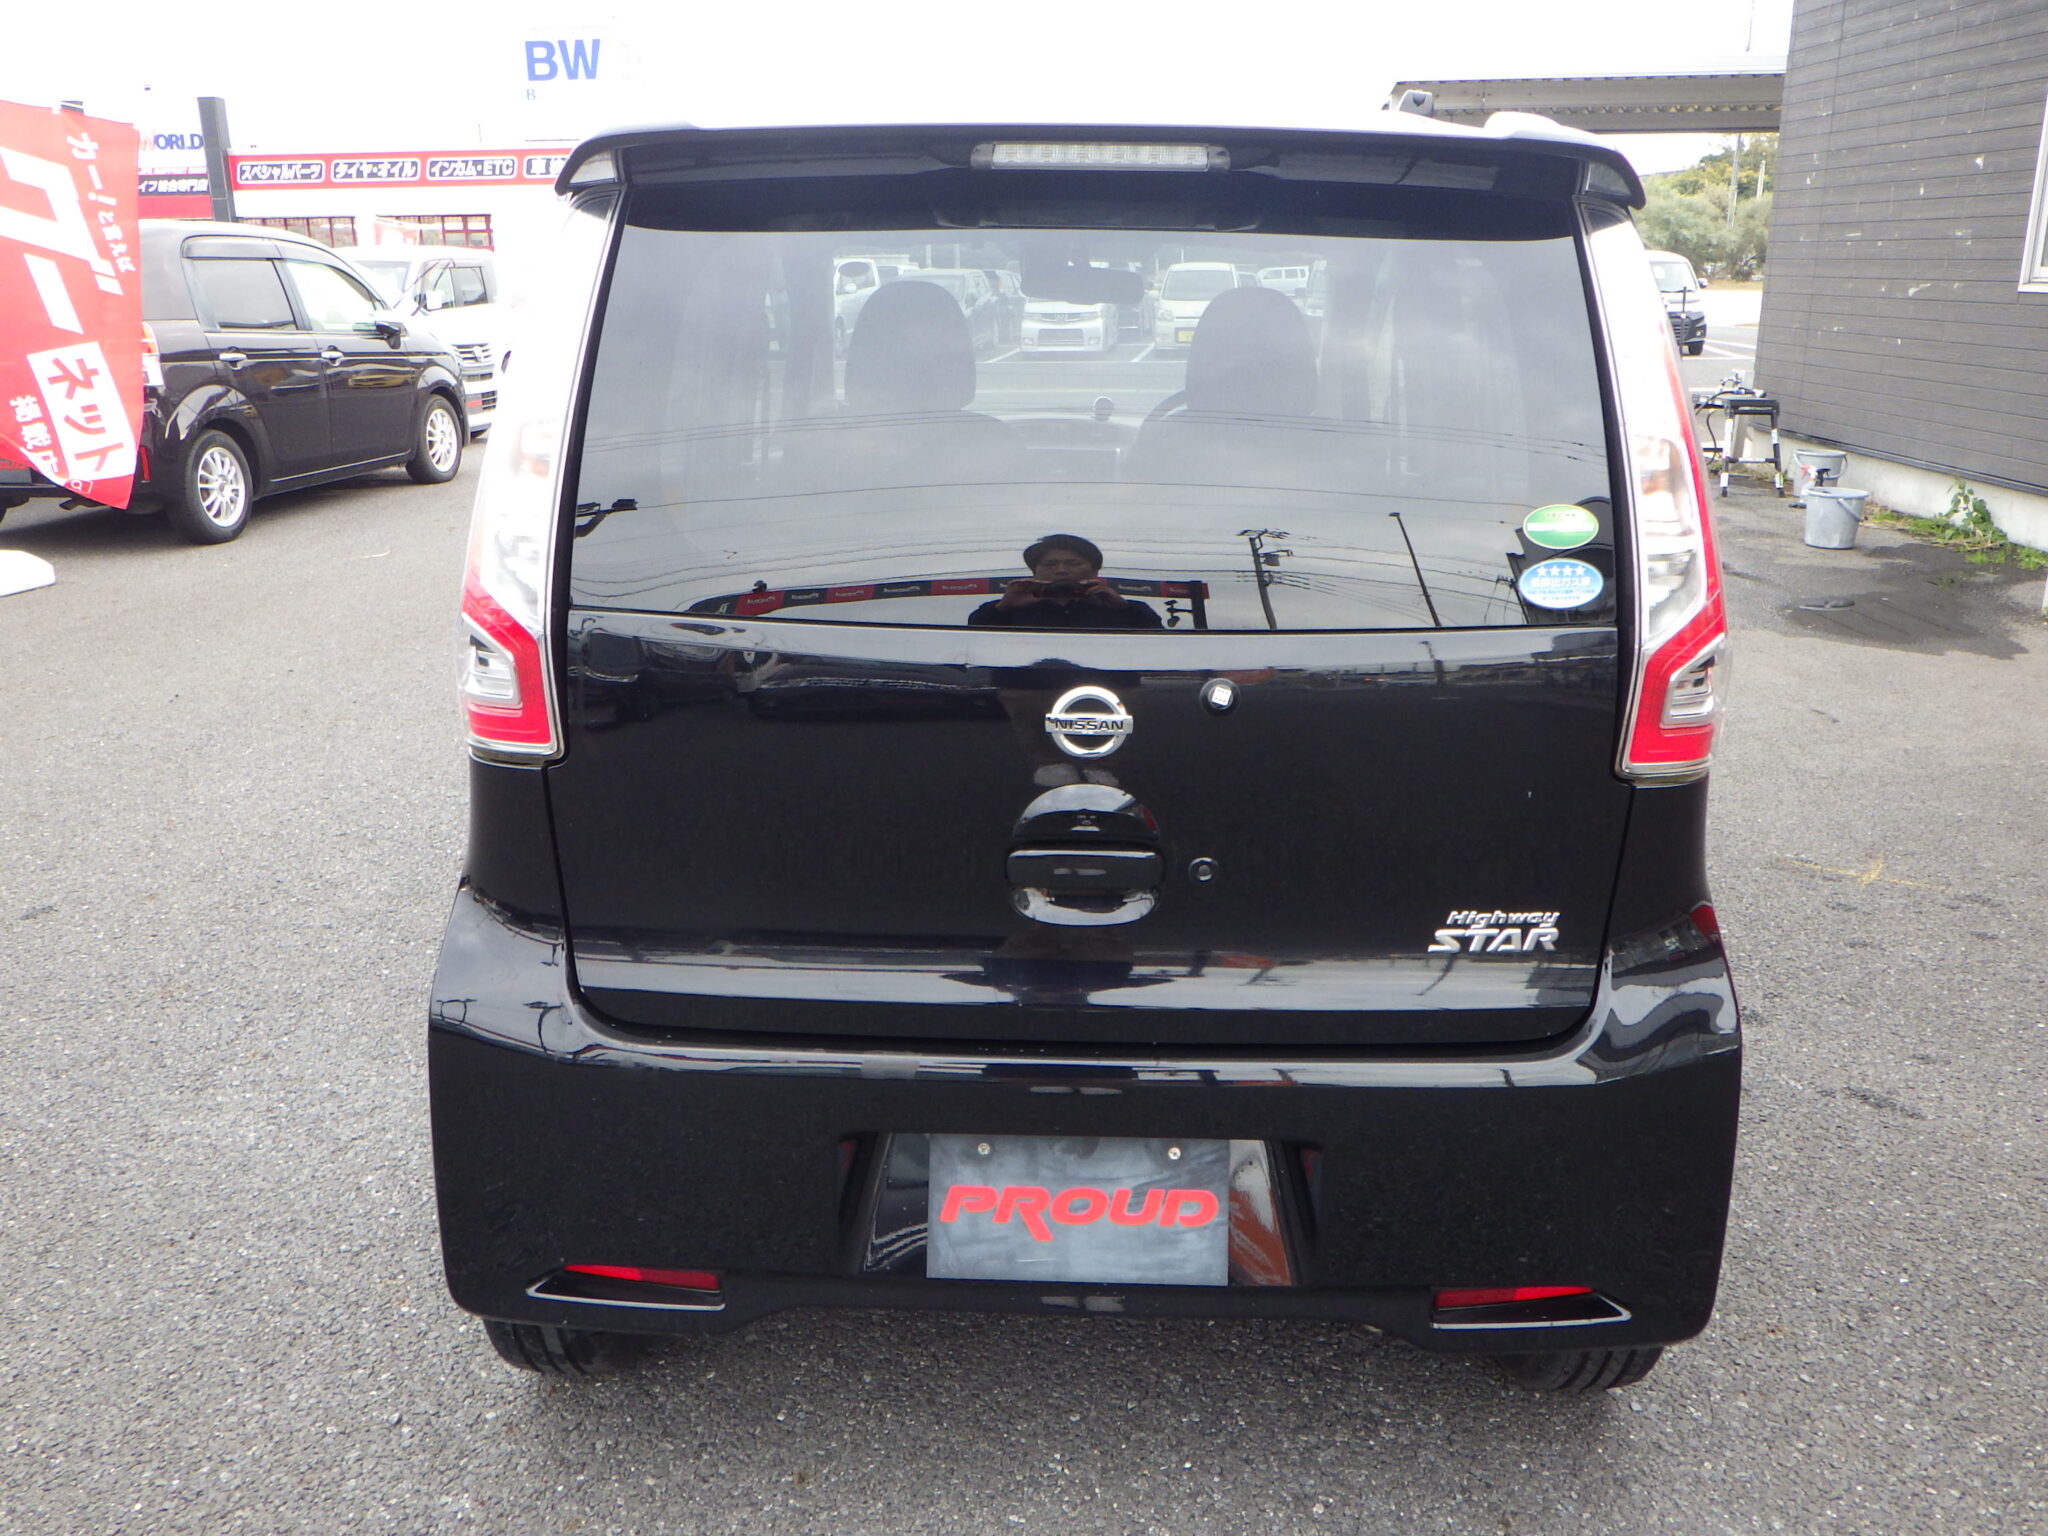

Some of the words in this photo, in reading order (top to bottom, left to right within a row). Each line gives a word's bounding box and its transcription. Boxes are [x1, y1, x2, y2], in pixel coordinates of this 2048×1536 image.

[525, 39, 601, 81] BW
[1054, 719, 1125, 731] NISSAN
[1446, 910, 1560, 929] Highway
[1427, 928, 1559, 952] STAR
[939, 1184, 1219, 1242] PROUD
